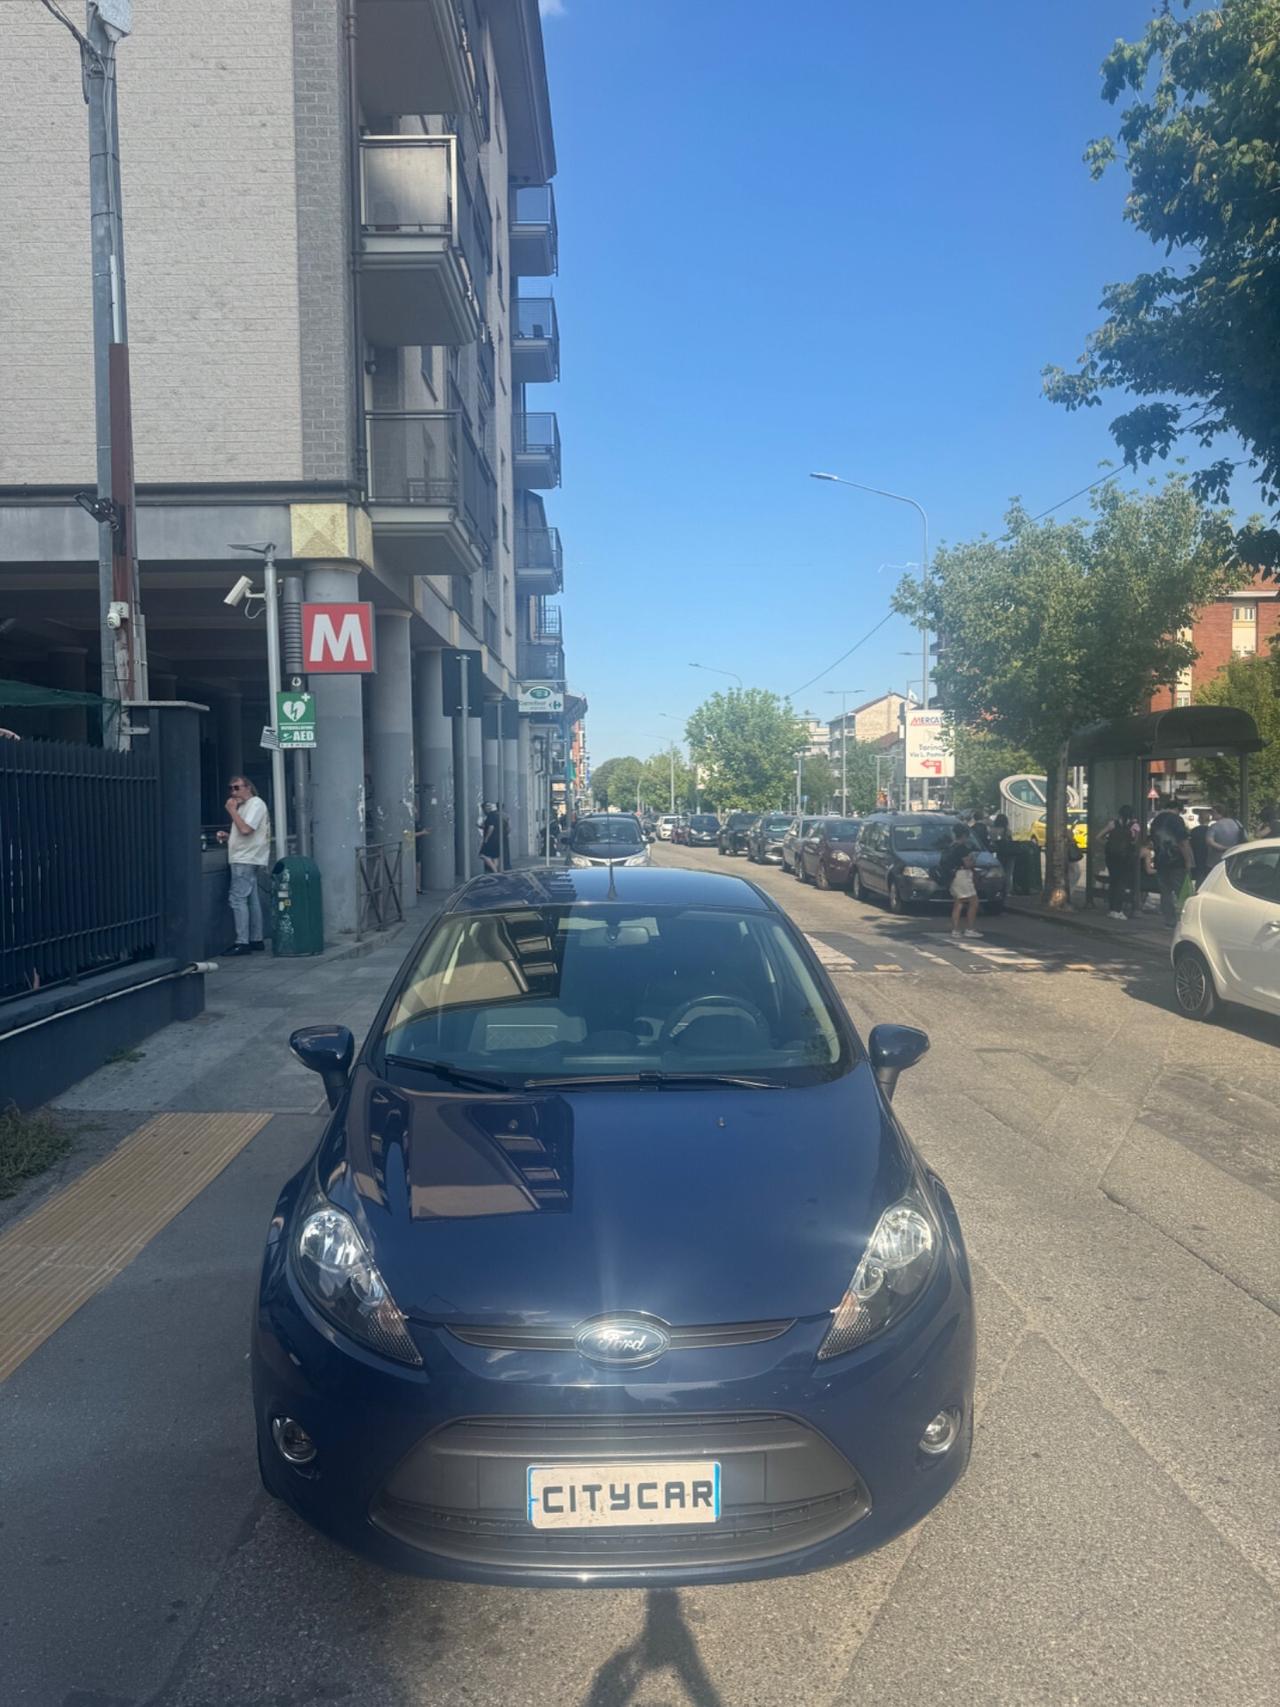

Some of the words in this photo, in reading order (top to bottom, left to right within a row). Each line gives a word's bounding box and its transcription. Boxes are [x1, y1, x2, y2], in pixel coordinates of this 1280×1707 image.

[309, 613, 368, 662] M
[293, 730, 314, 741] AED
[600, 1328, 645, 1351] Ford
[542, 1480, 713, 1514] CITYCAR
